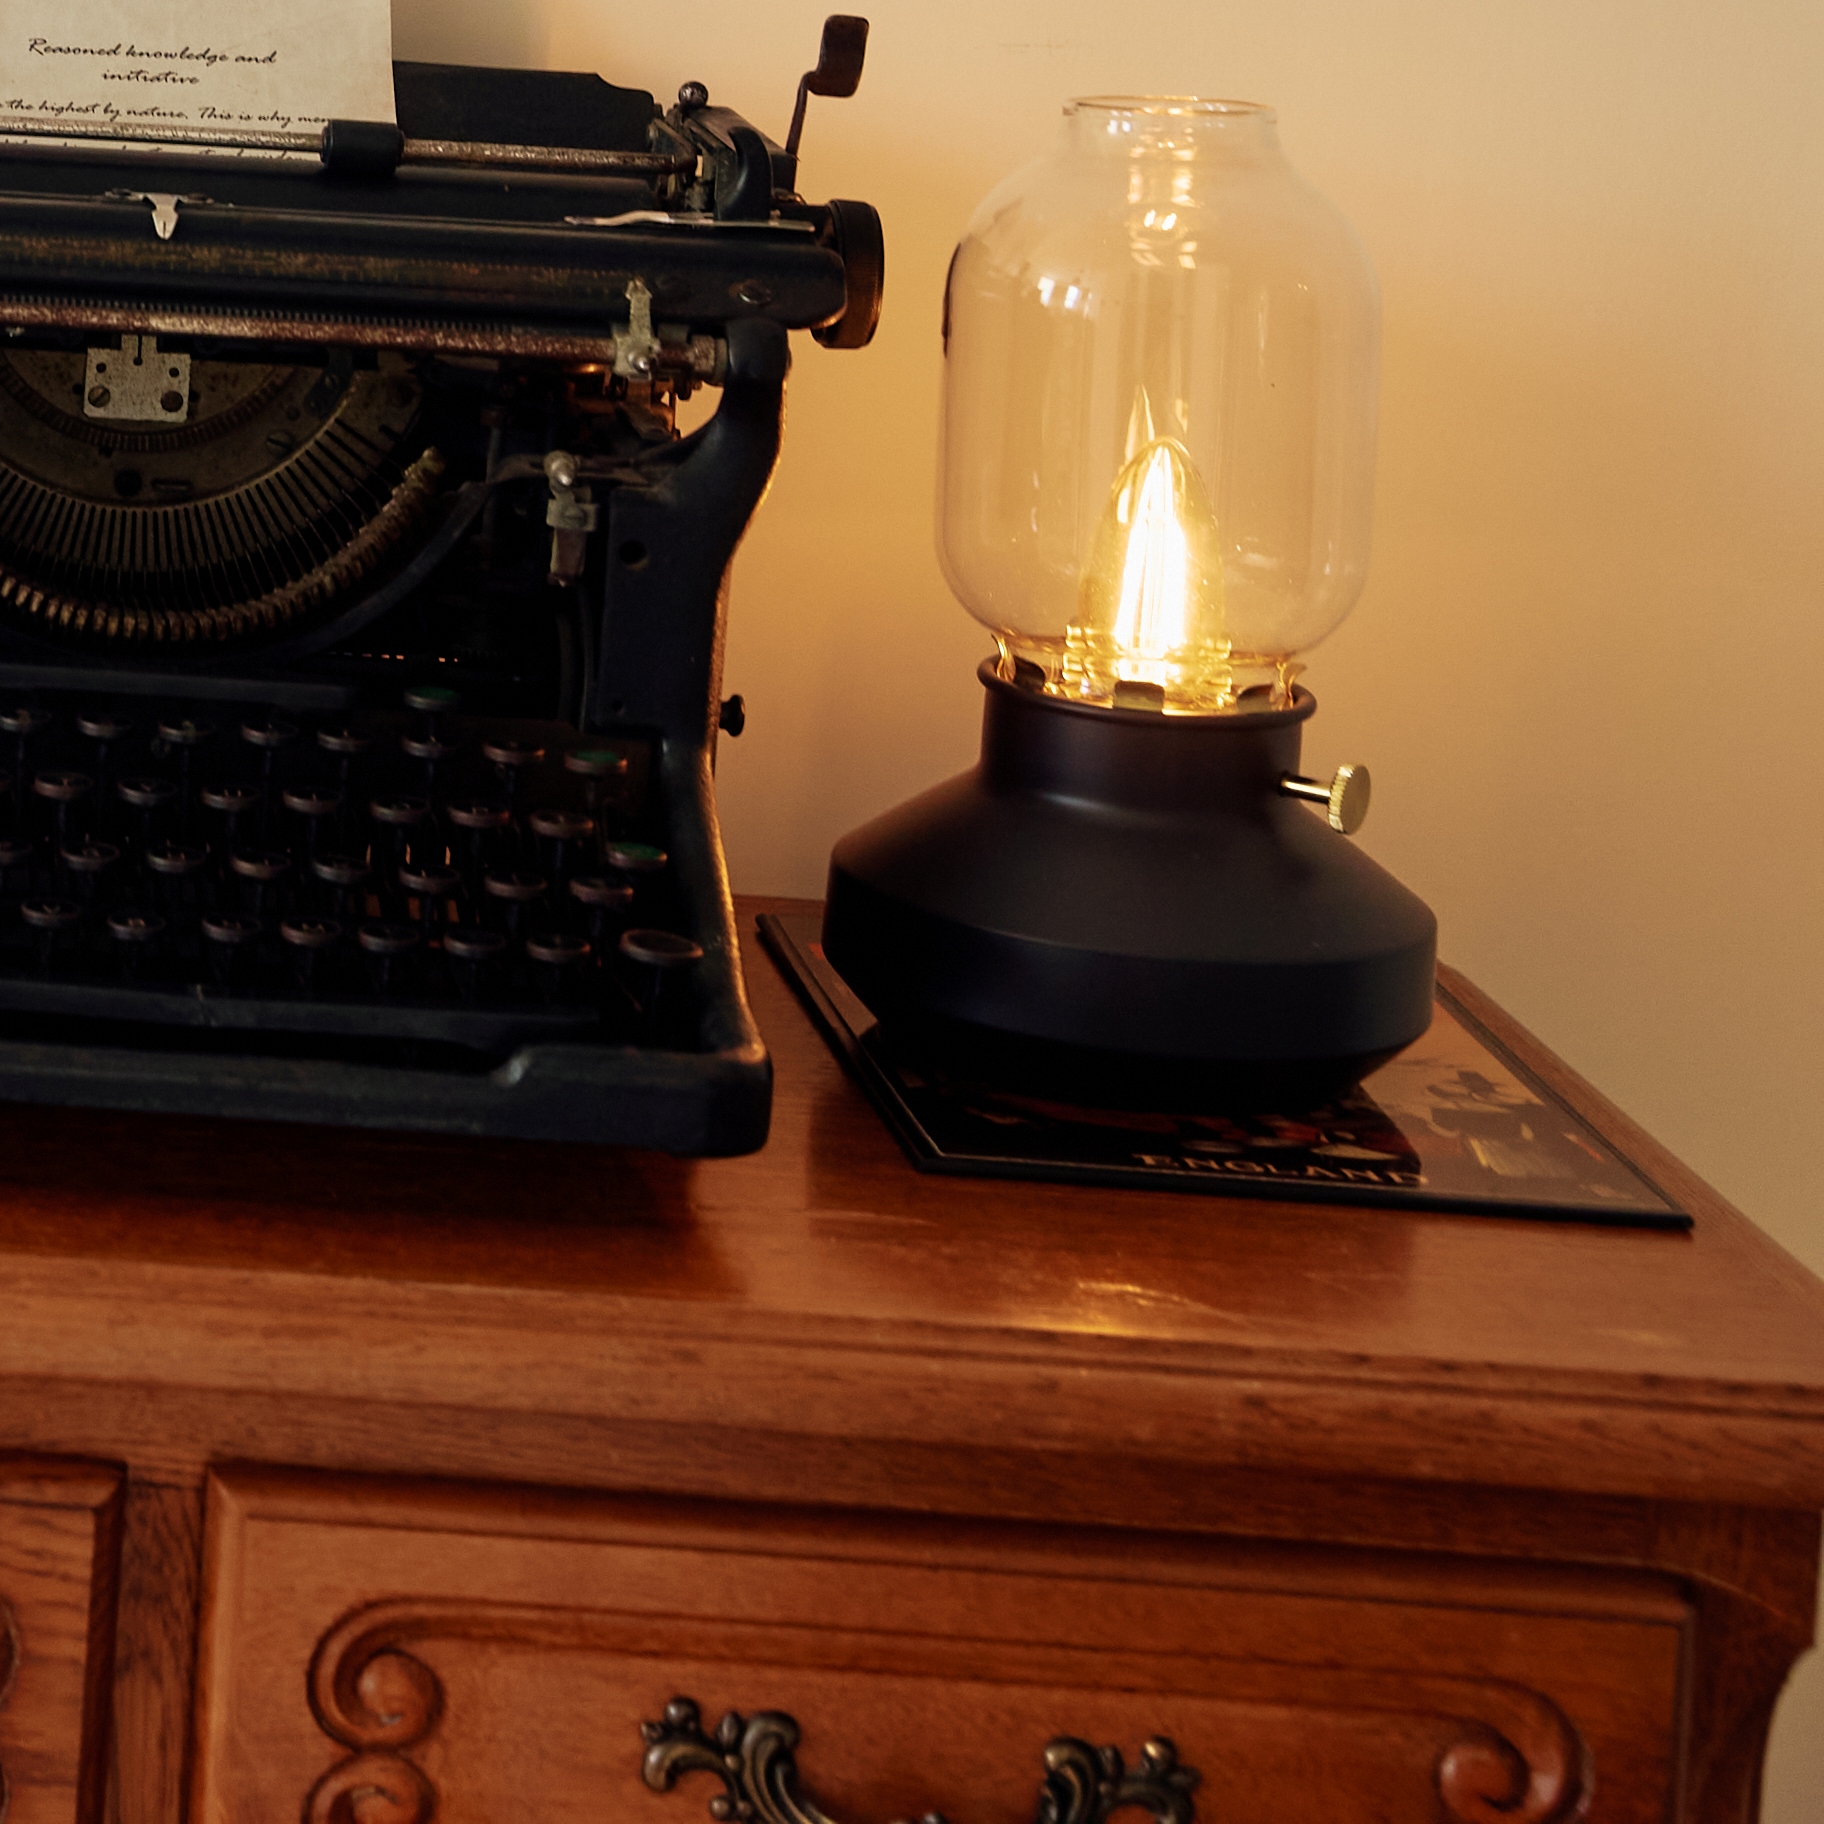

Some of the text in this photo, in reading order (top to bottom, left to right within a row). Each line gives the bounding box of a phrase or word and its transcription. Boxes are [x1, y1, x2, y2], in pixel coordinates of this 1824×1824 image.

[28, 36, 277, 66] Reasoned knowledge and
[101, 68, 200, 86] initiative
[6, 97, 35, 110] the
[37, 100, 99, 118] highest
[101, 104, 123, 120] by
[126, 105, 190, 119] nature.
[198, 105, 233, 121] This
[237, 110, 253, 122] is
[257, 111, 293, 128] why
[1132, 1153, 1430, 1188] ENGLAND
